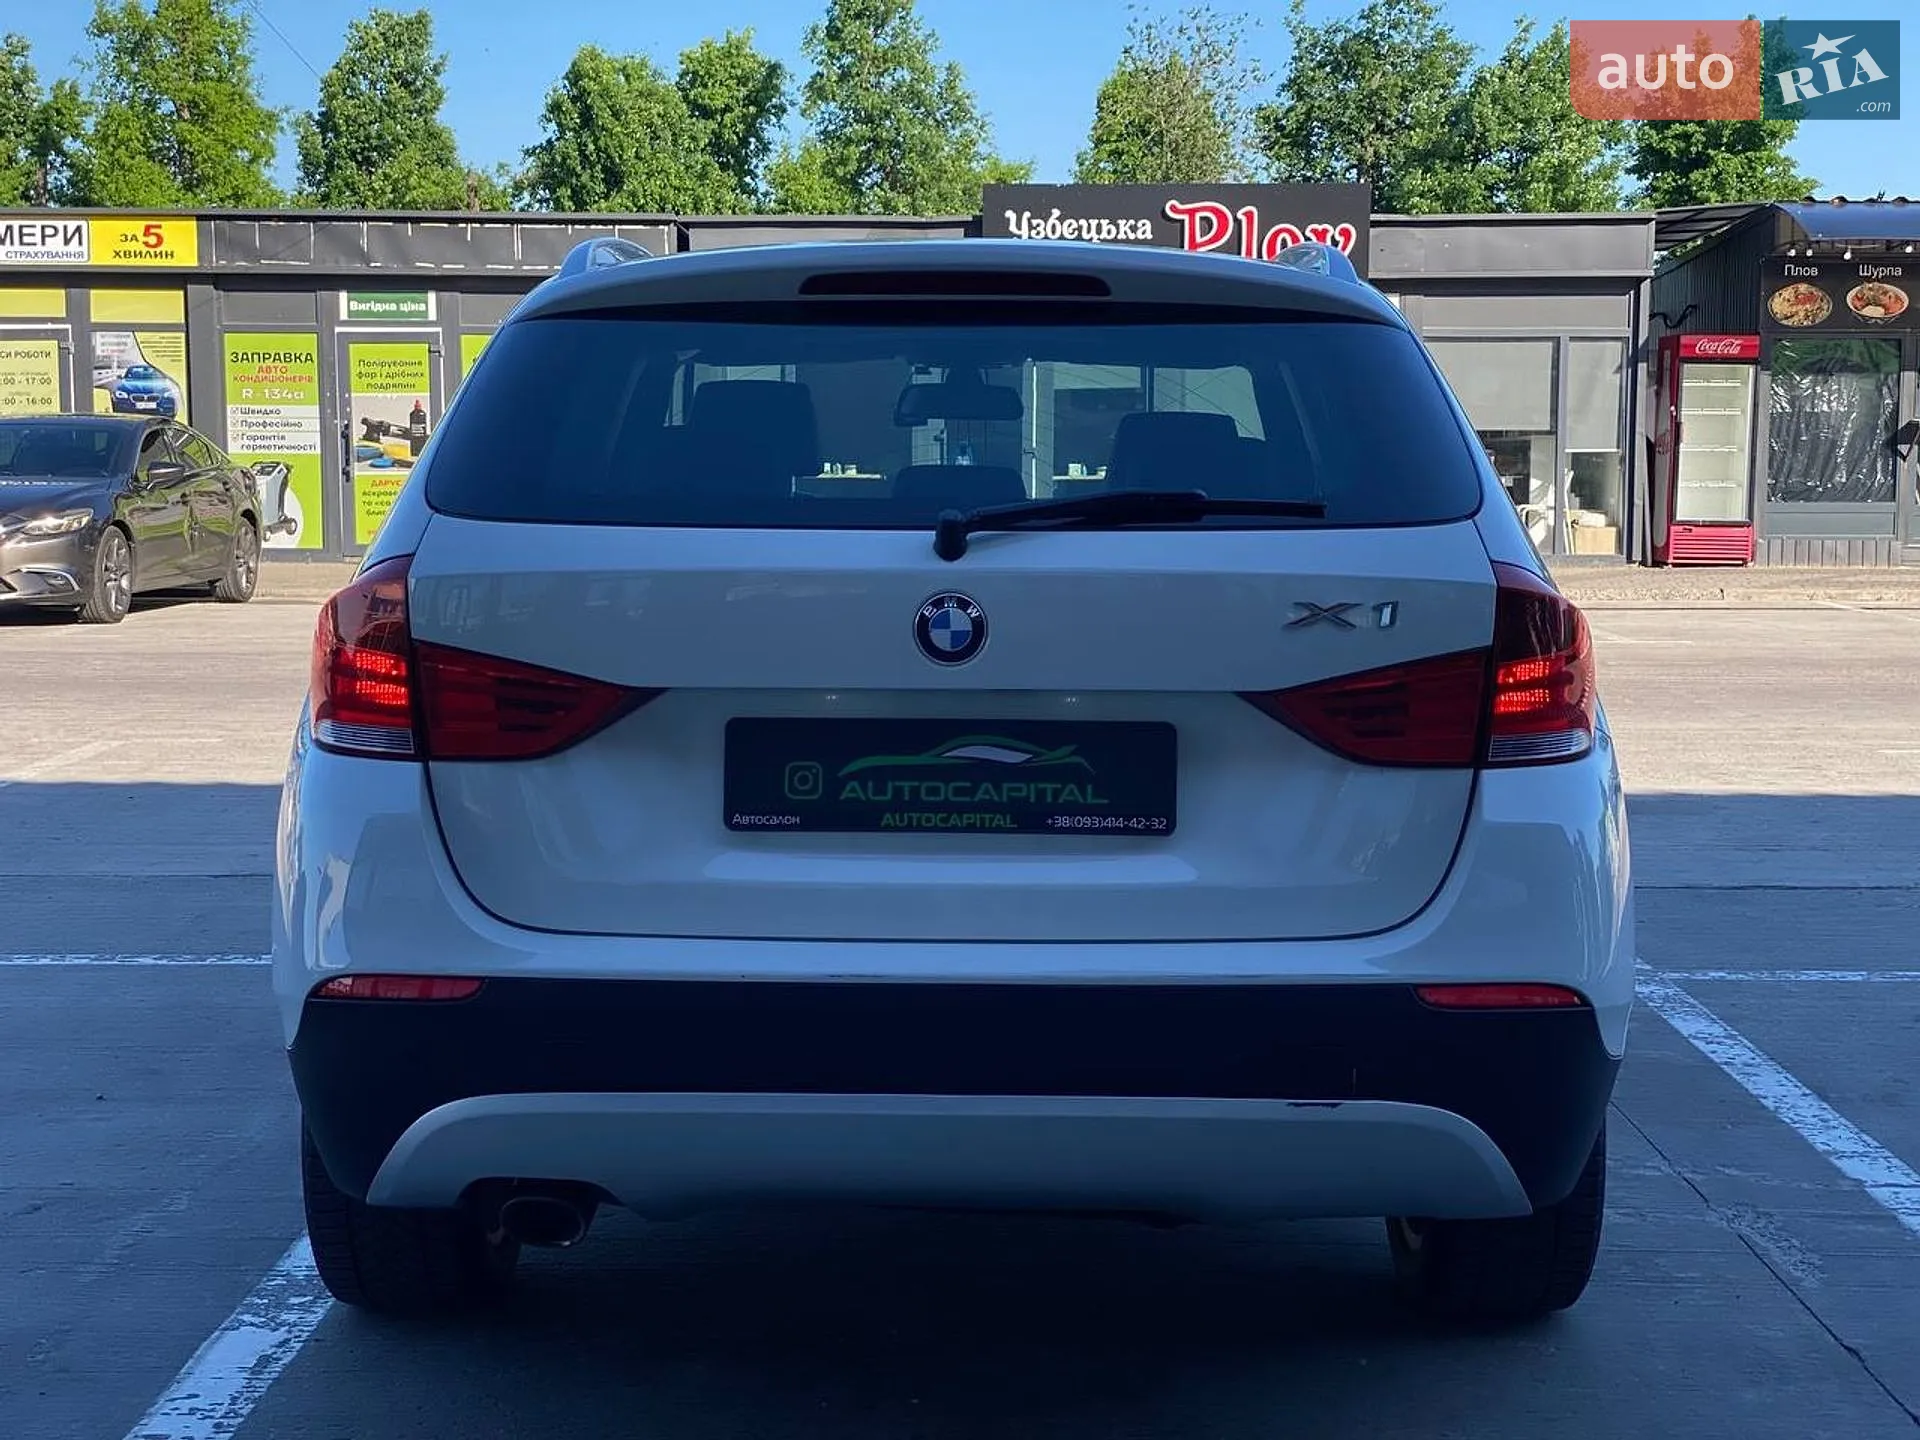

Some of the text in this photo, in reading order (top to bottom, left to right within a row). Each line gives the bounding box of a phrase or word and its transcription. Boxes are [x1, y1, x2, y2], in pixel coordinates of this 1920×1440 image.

[1004, 208, 1153, 243] Узбецька
[120, 224, 164, 248] ЗА 5
[5, 250, 84, 259] СТРАХУВАННЯ
[113, 250, 174, 259] ХВИЛИН
[1784, 264, 1819, 277] Плов
[1859, 264, 1902, 278] Шурпа
[349, 300, 426, 312] Вигідна ціна
[14, 351, 51, 359] РОБОТИ
[230, 352, 314, 363] ЗАПРАВКА
[257, 365, 288, 374] АВТО
[240, 407, 281, 415] Швидко
[1284, 601, 1399, 628] X1
[839, 780, 1109, 804] AUTOCAPITAL
[732, 813, 800, 826] Автосалон
[880, 812, 1018, 828] AUTOCAPITAL
[1045, 815, 1168, 830] +38(093)414-42-32
